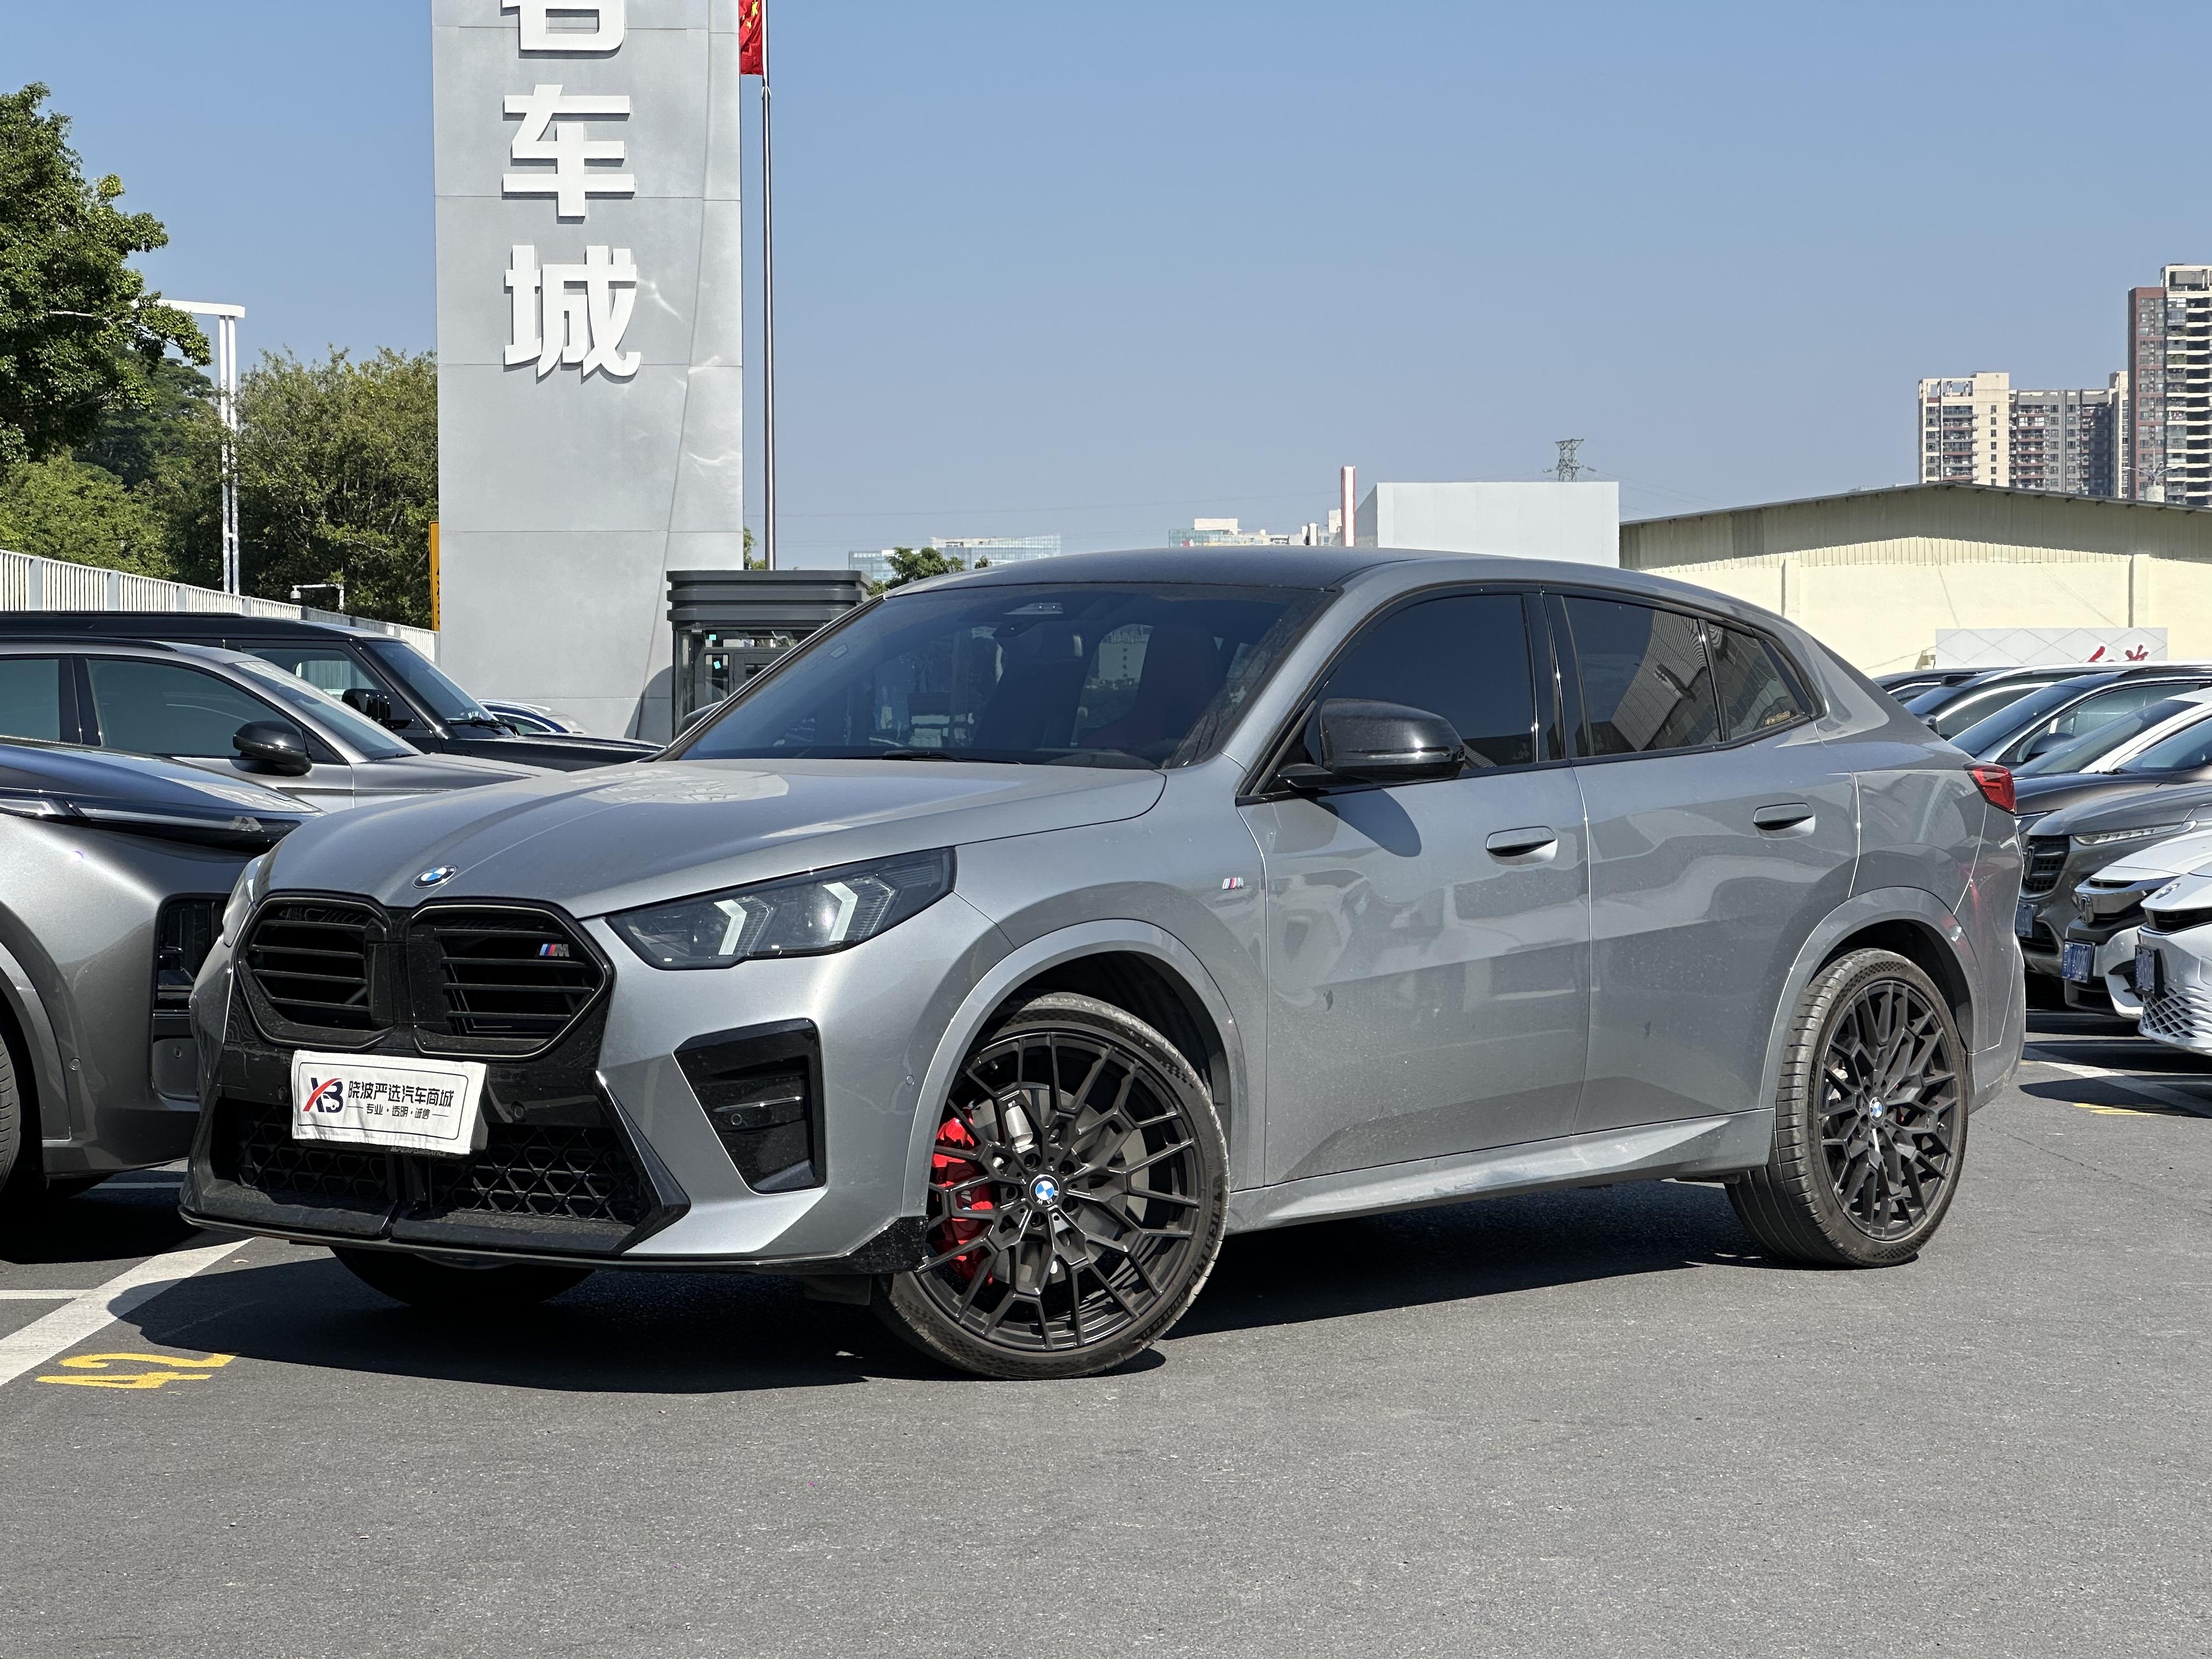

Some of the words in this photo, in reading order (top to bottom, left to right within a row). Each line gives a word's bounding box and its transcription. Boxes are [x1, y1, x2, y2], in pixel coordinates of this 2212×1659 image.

[552, 944, 570, 957] M
[348, 1080, 454, 1108] 晓波严选汽车商城
[1188, 1199, 1221, 1288] MICHELIN
